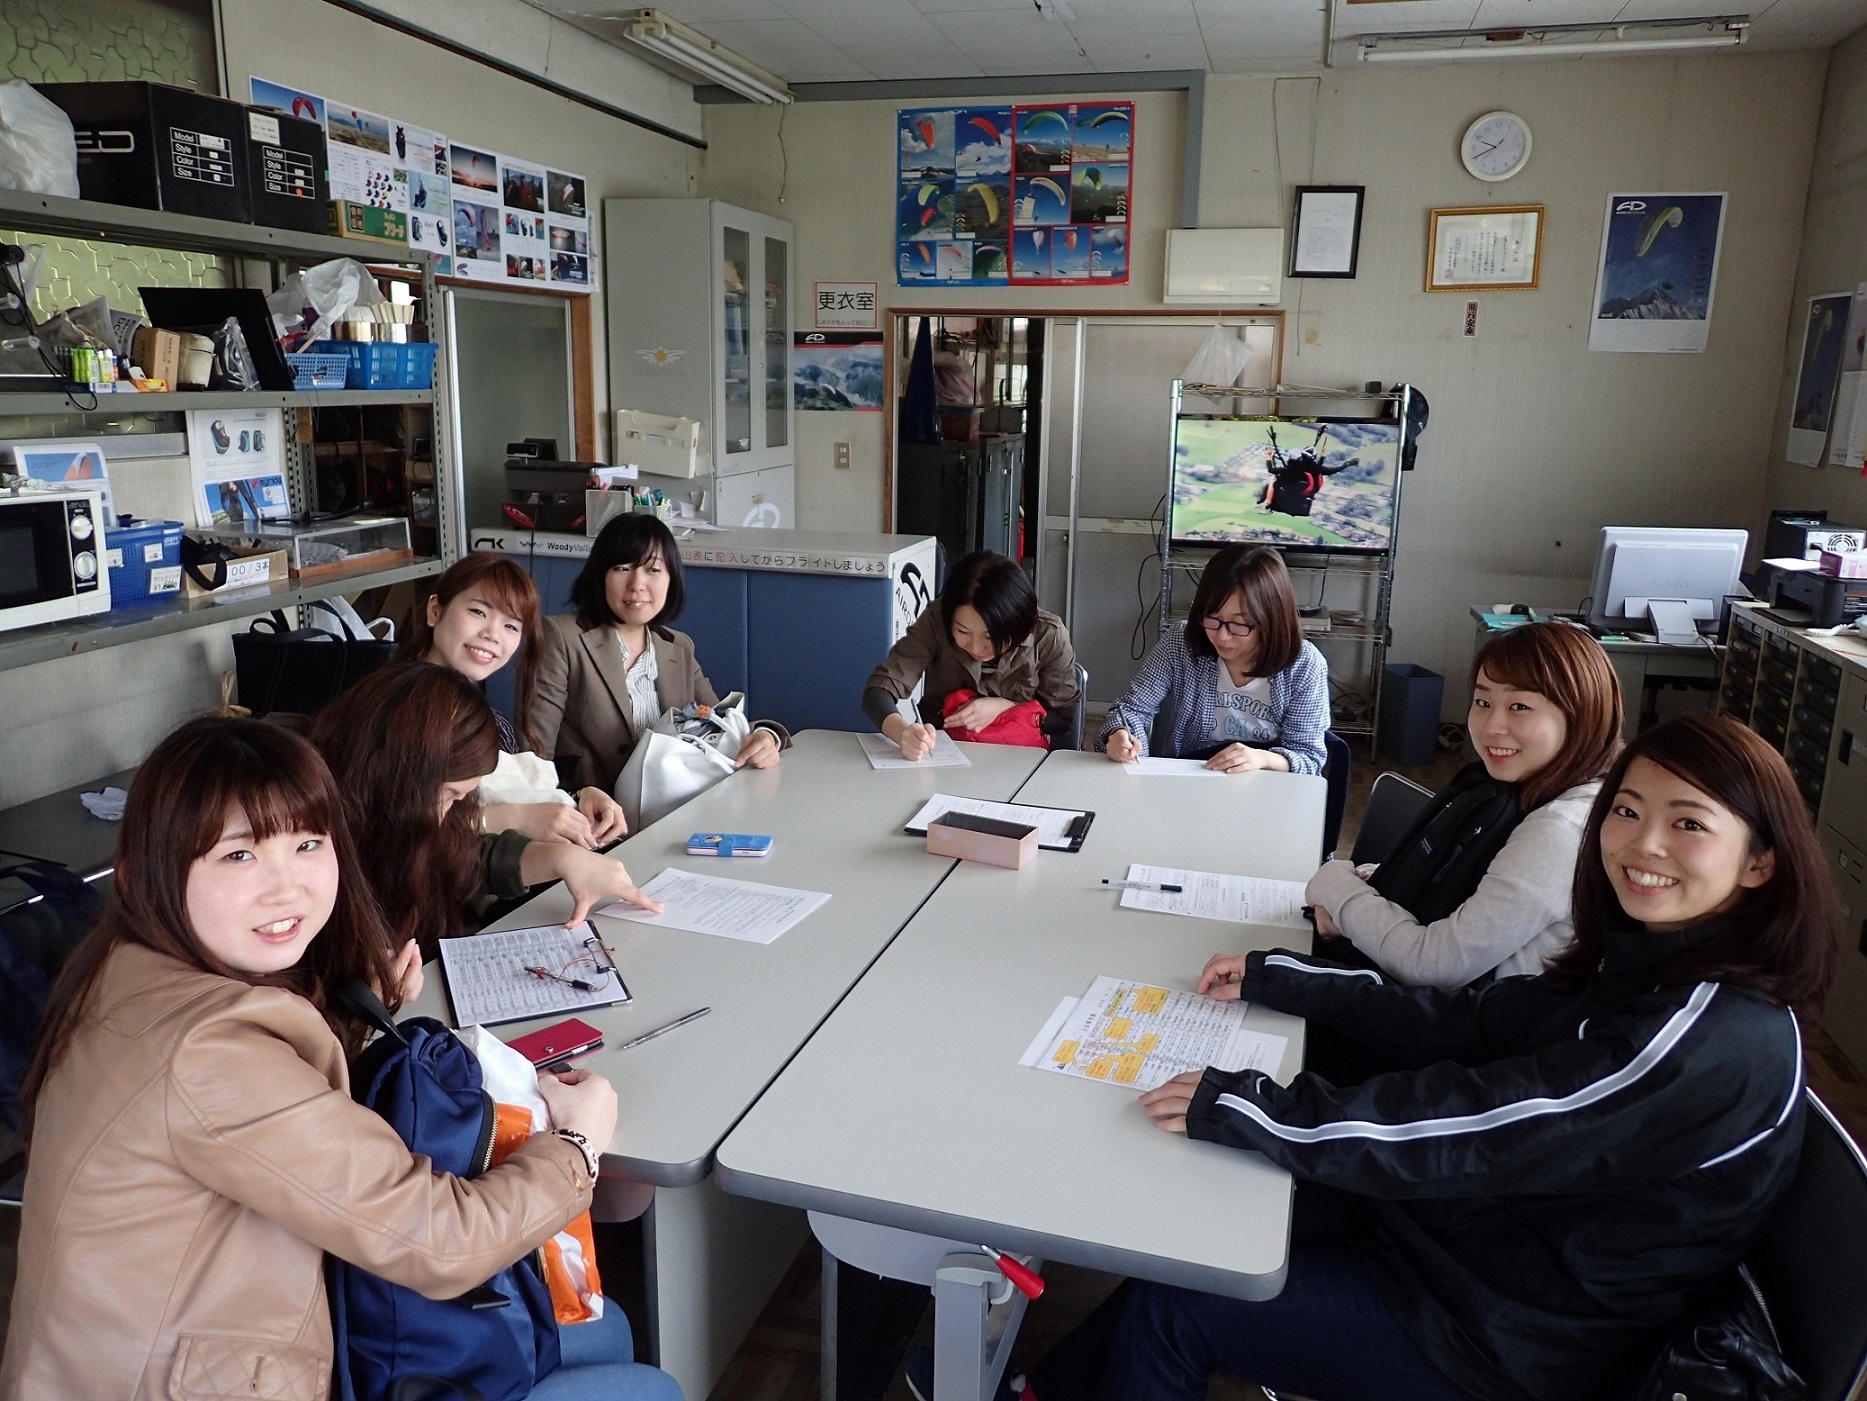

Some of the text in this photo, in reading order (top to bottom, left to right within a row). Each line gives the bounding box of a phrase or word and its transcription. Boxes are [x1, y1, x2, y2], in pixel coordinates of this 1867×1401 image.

[174, 131, 195, 143] Model
[175, 143, 192, 154] Style
[266, 149, 284, 160] Model
[176, 155, 195, 166] Color
[267, 160, 282, 170] Style
[177, 167, 193, 178] Size
[268, 171, 284, 181] Color
[268, 182, 282, 192] Size
[818, 291, 874, 311] 更衣室
[1223, 714, 1271, 740] CA 94
